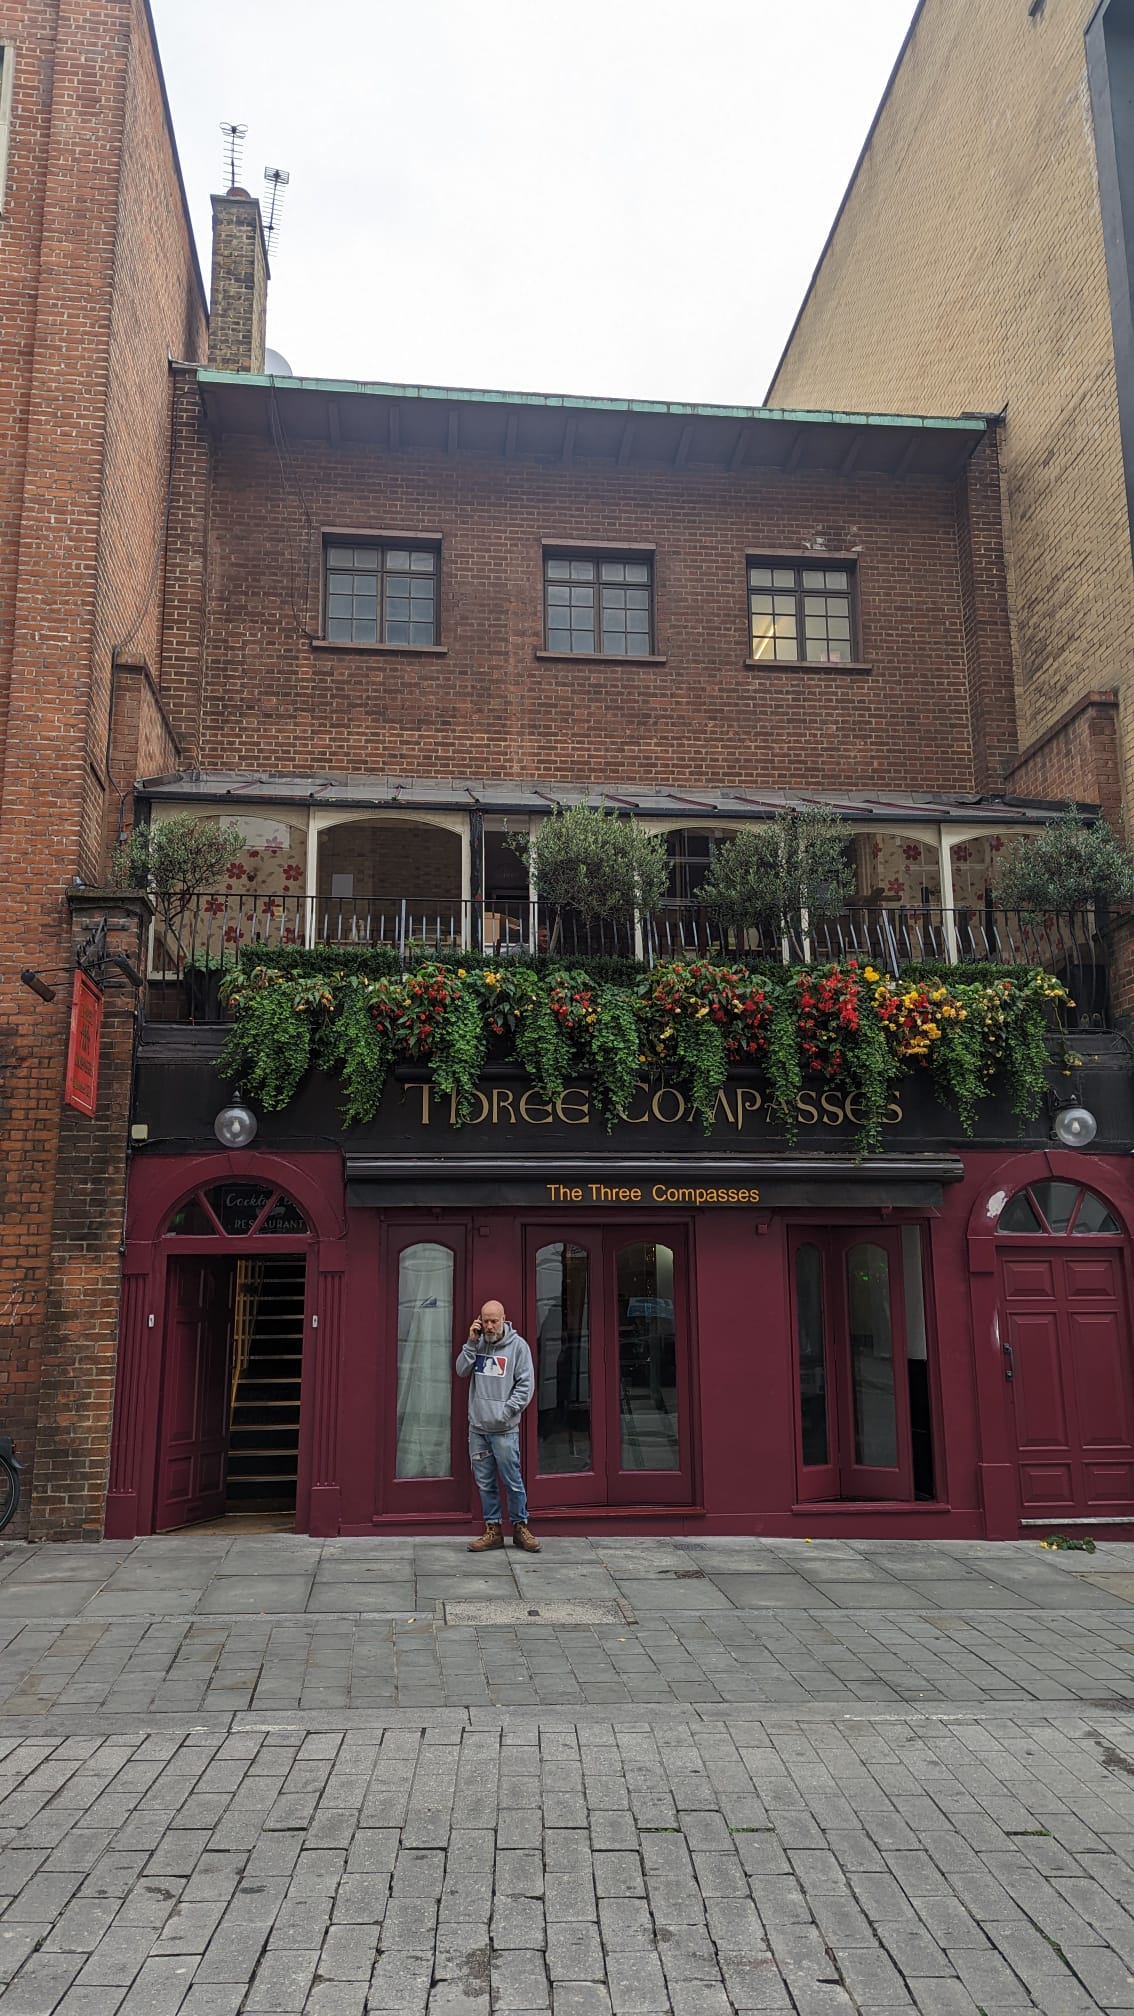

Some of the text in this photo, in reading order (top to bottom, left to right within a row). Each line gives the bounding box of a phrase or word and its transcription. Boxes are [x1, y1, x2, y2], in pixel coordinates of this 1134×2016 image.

[546, 1184, 760, 1206] The Three Compasses
[234, 1219, 305, 1230] RESAURANT
